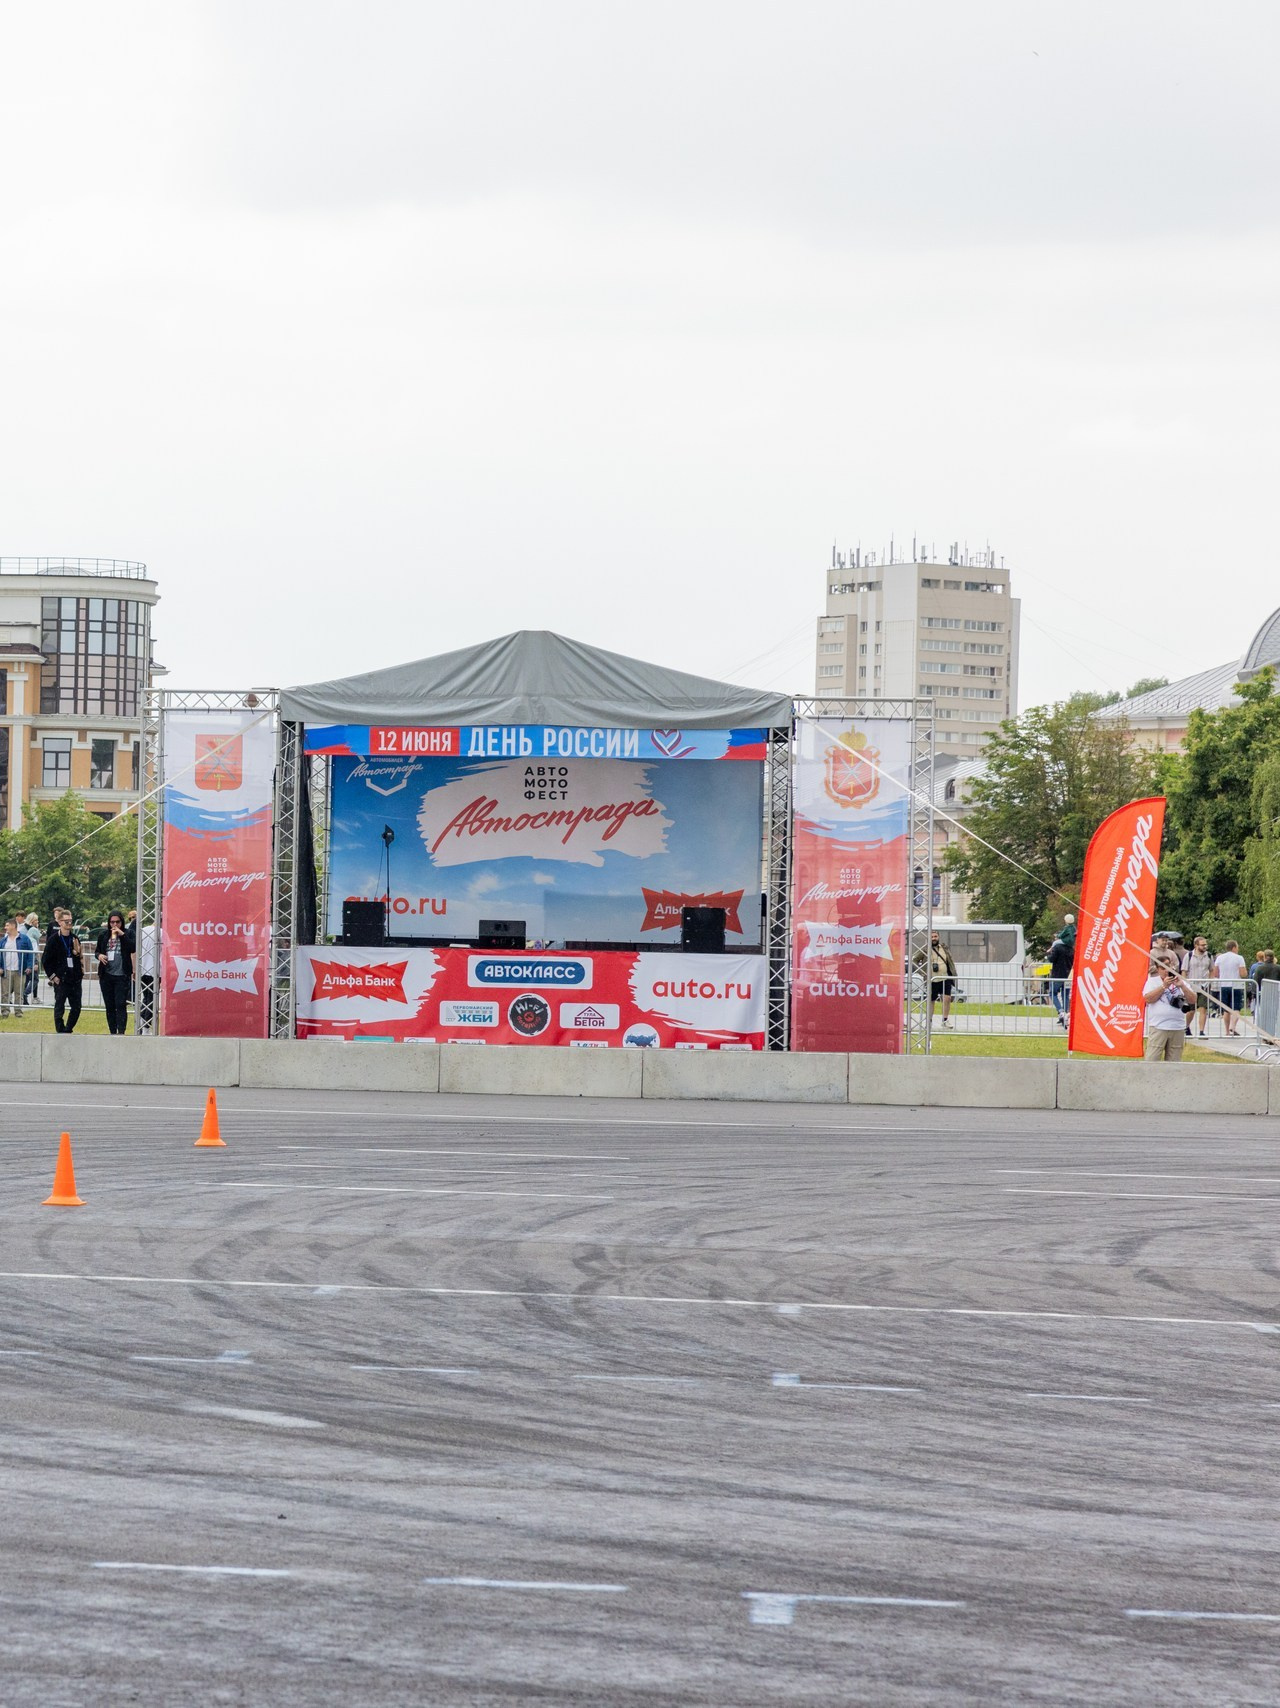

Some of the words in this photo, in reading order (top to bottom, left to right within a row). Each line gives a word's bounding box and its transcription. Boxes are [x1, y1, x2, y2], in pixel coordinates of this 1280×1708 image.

[378, 731, 397, 751] 12
[402, 731, 452, 752] ИЮНЯ
[468, 727, 533, 757] ДЕНЬ
[543, 728, 639, 757] РОССИИ
[346, 762, 424, 783] Автострада
[524, 766, 569, 776] АВТО
[524, 778, 569, 788] МОТО
[523, 790, 569, 800] ФЕСТ
[431, 795, 660, 853] Автострада
[167, 870, 267, 897] Автострада
[798, 881, 902, 908] Автострада
[345, 893, 447, 915] to.ru
[1084, 917, 1102, 960] ОТКРЫТЫЙ
[1098, 847, 1124, 916] АВТОМОБИЛЬНЫЙ
[179, 920, 255, 936] auto.ru
[1077, 814, 1158, 1049] Автострада
[816, 933, 852, 946] Альфа
[855, 934, 882, 945] Банк
[184, 968, 219, 981] Альфа
[221, 969, 247, 980] Банк
[322, 973, 363, 986] Альфа
[365, 974, 396, 987] Банк
[484, 965, 576, 979] АВТОКЛАСС
[652, 979, 752, 1000] auto.ru
[809, 982, 888, 997] auto.ru
[458, 1013, 493, 1023] ЖБИ
